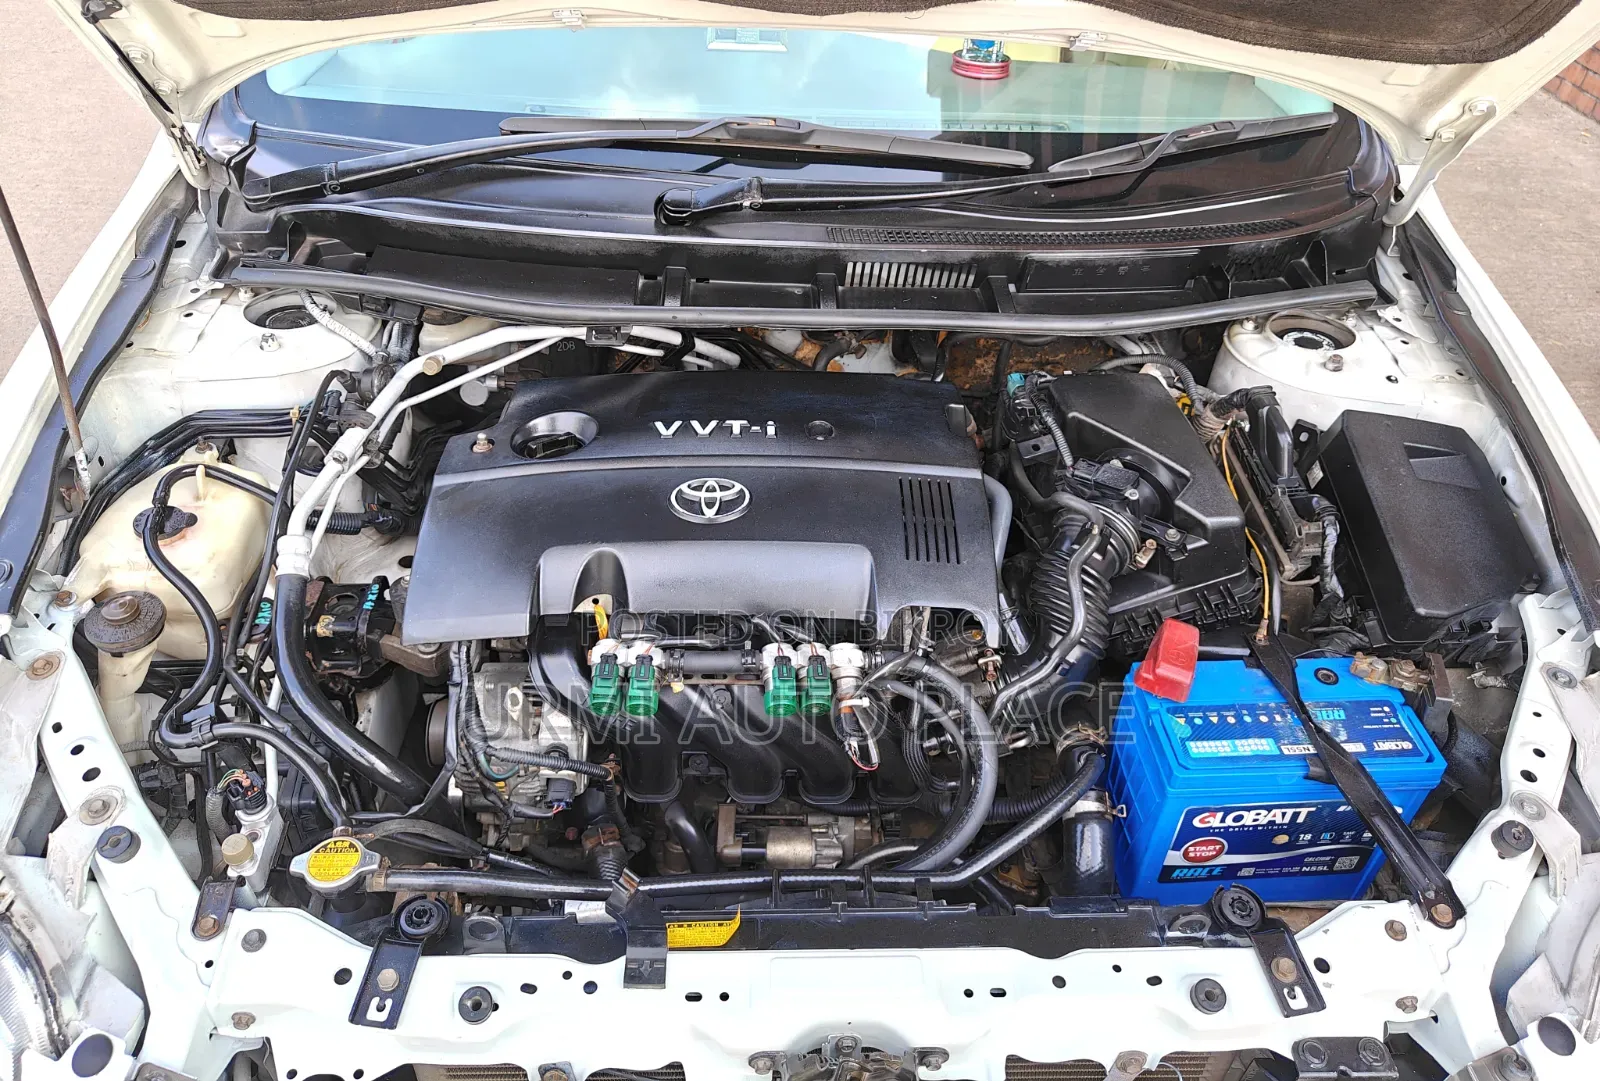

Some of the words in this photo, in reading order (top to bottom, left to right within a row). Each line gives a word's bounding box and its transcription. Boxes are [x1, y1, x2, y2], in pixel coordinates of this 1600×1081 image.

[653, 420, 777, 438] VVT-i
[1192, 807, 1317, 828] GLOBATT
[1298, 833, 1312, 841] 18
[1170, 866, 1227, 878] RACE
